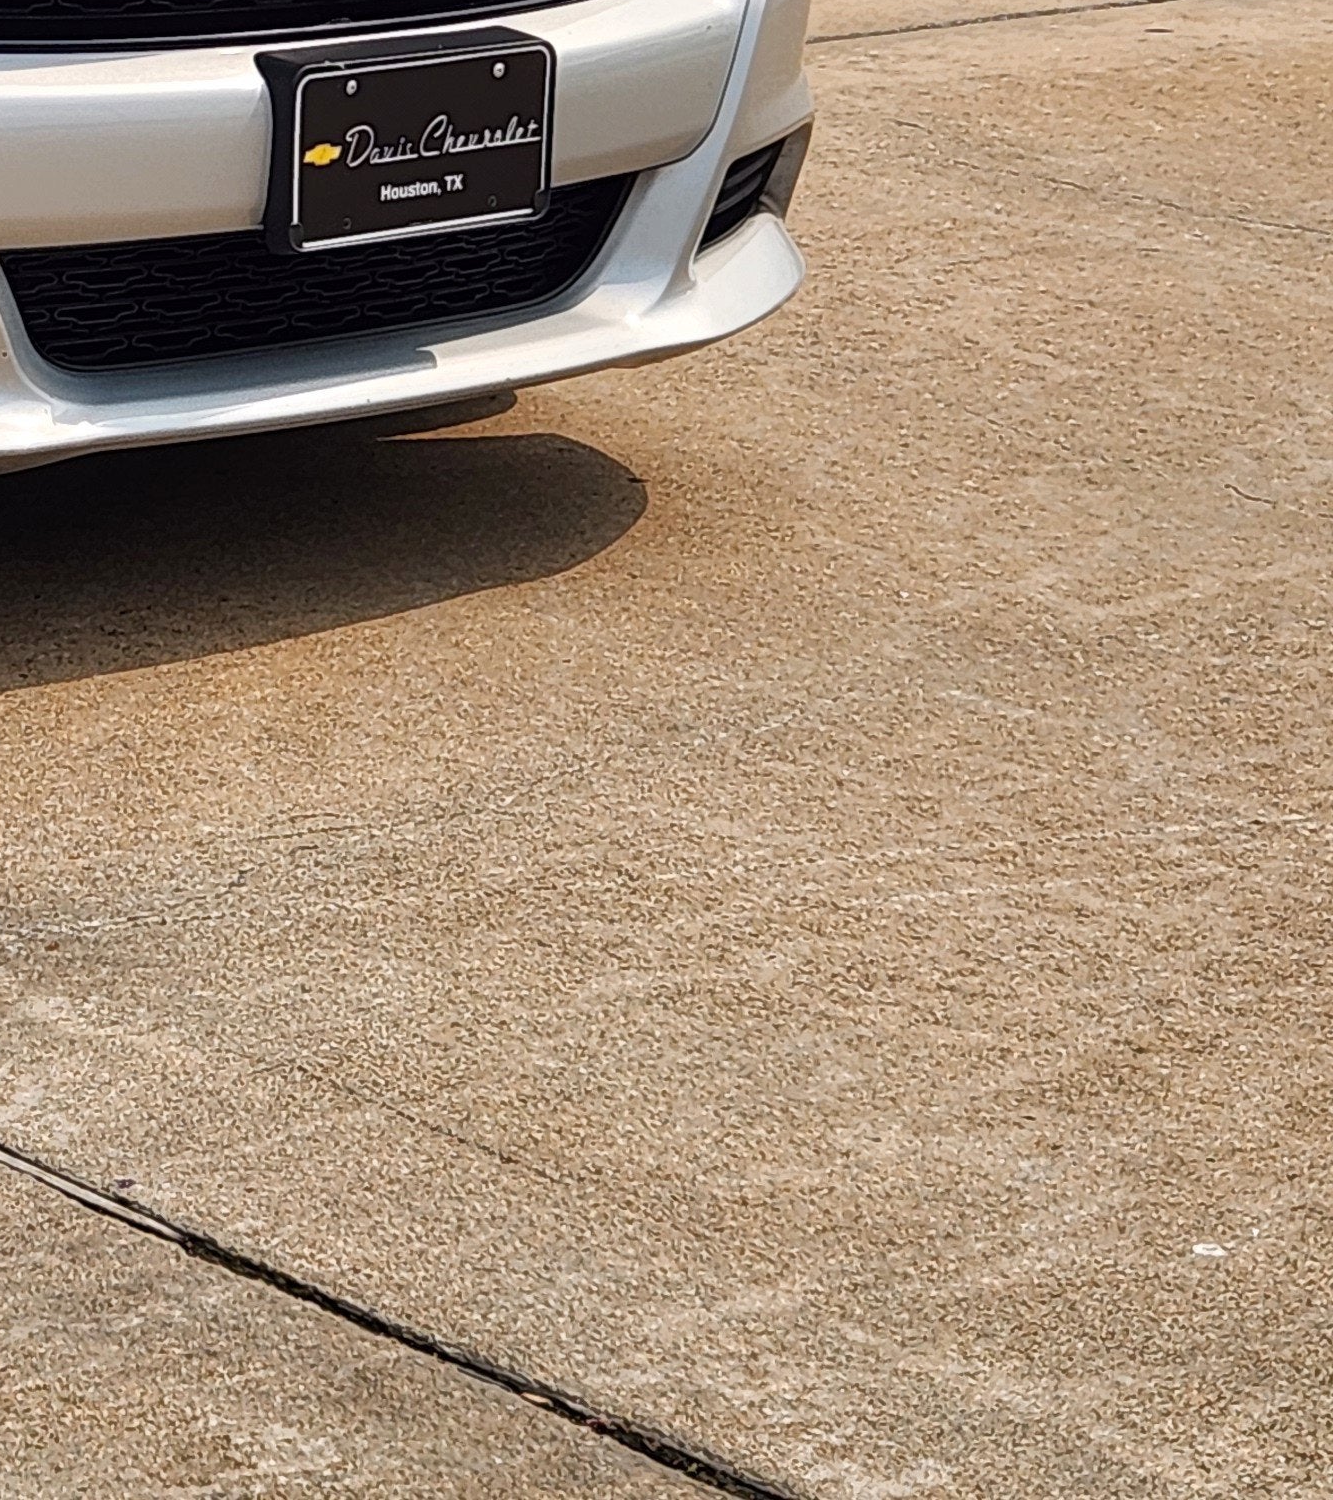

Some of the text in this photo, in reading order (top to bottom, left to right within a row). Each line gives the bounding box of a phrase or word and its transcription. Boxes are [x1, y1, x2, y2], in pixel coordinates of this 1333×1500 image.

[345, 114, 542, 168] Davis Chevrolet
[380, 174, 464, 202] Houston, TX
